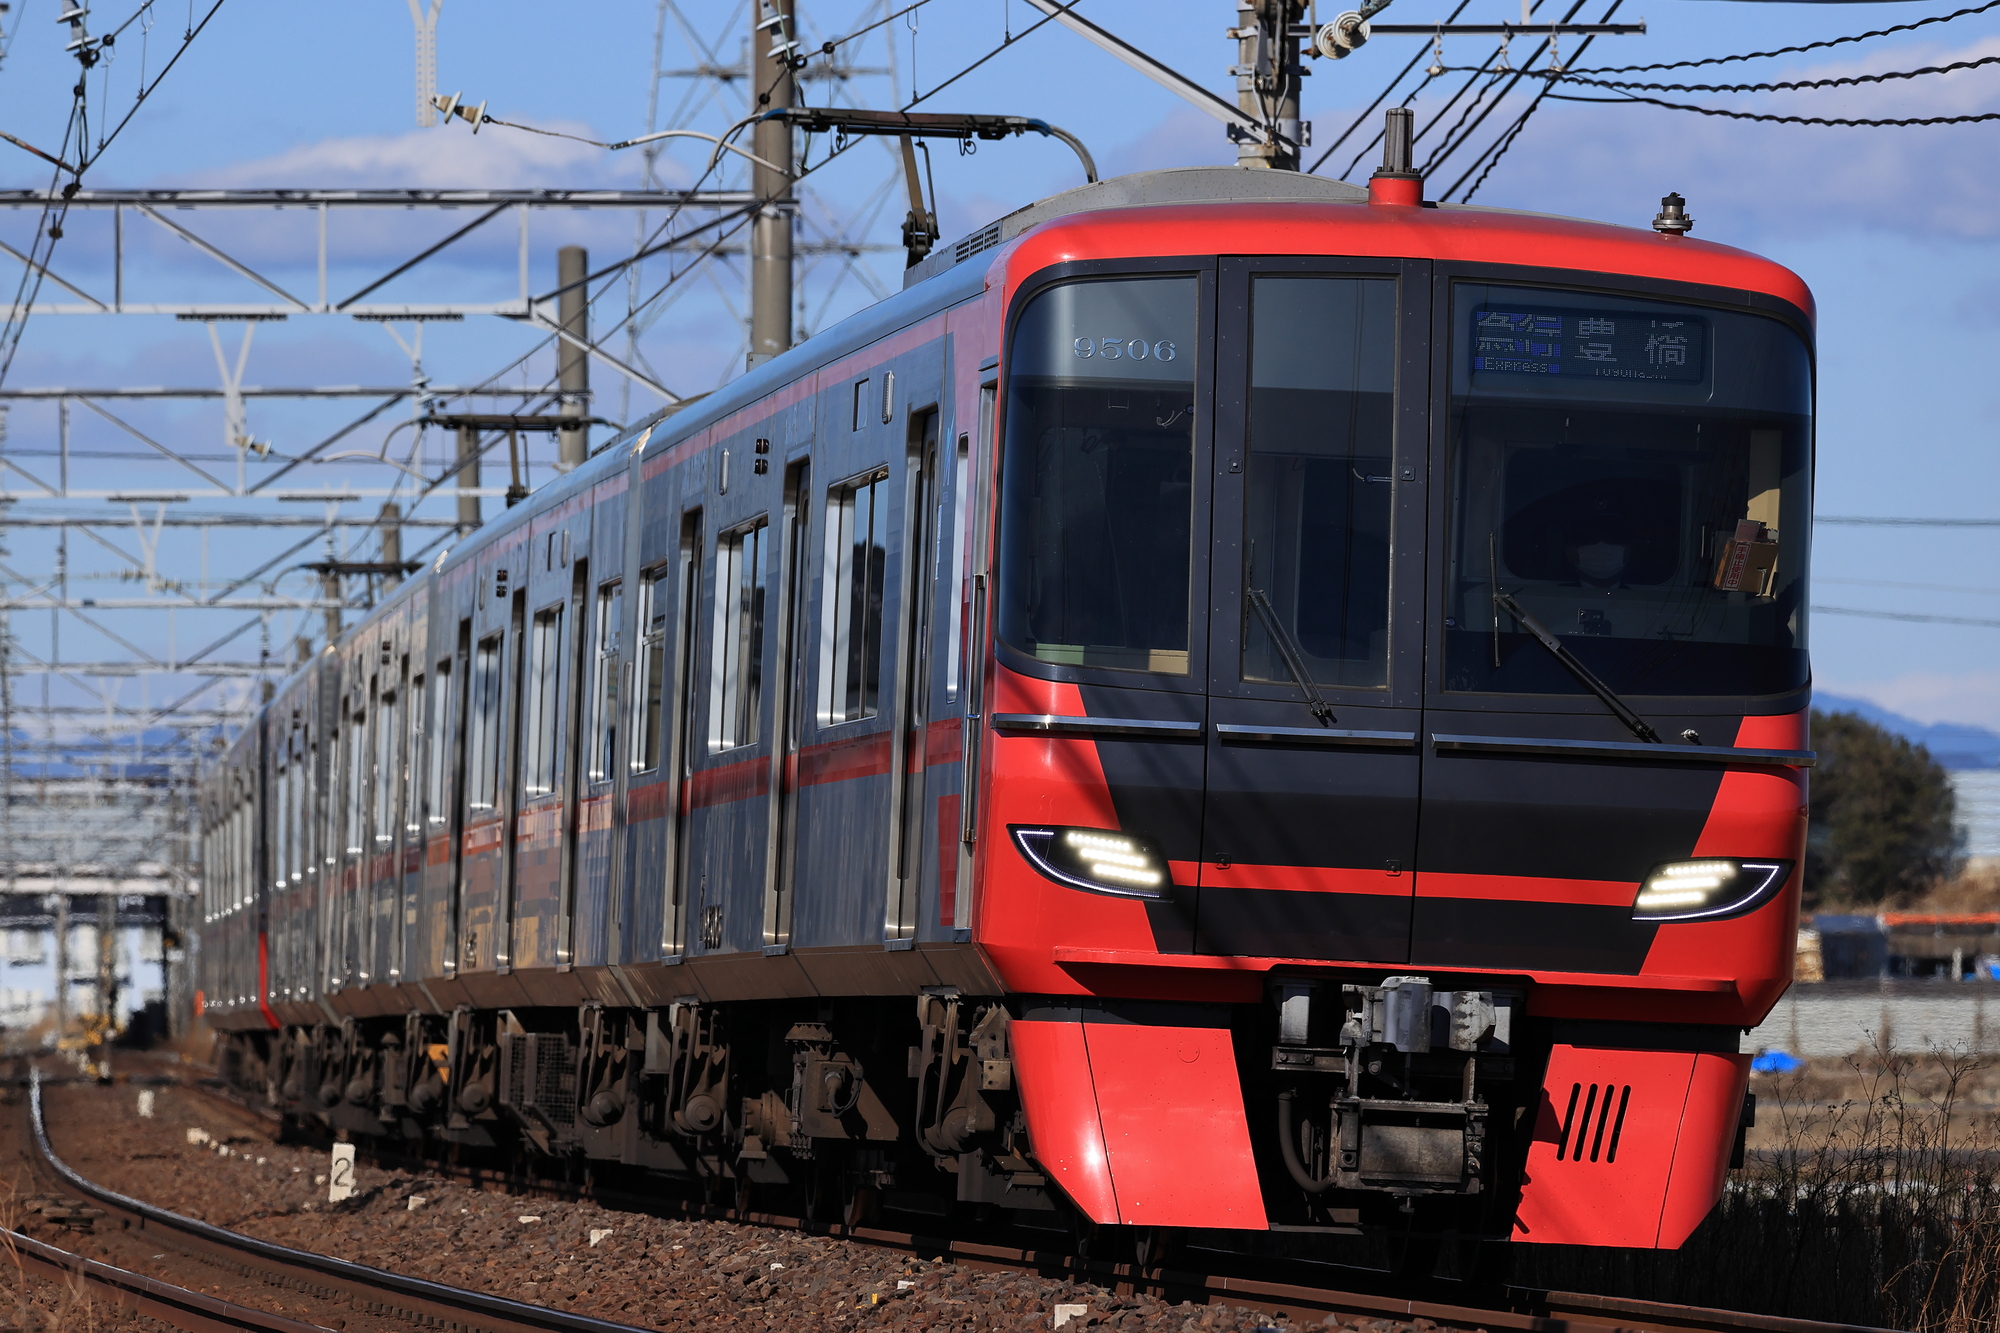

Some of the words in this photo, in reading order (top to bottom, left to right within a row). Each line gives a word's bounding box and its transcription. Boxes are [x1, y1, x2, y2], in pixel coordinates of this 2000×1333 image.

[1074, 336, 1176, 362] 9506
[1484, 357, 1548, 373] Express
[334, 1157, 351, 1187] 2
